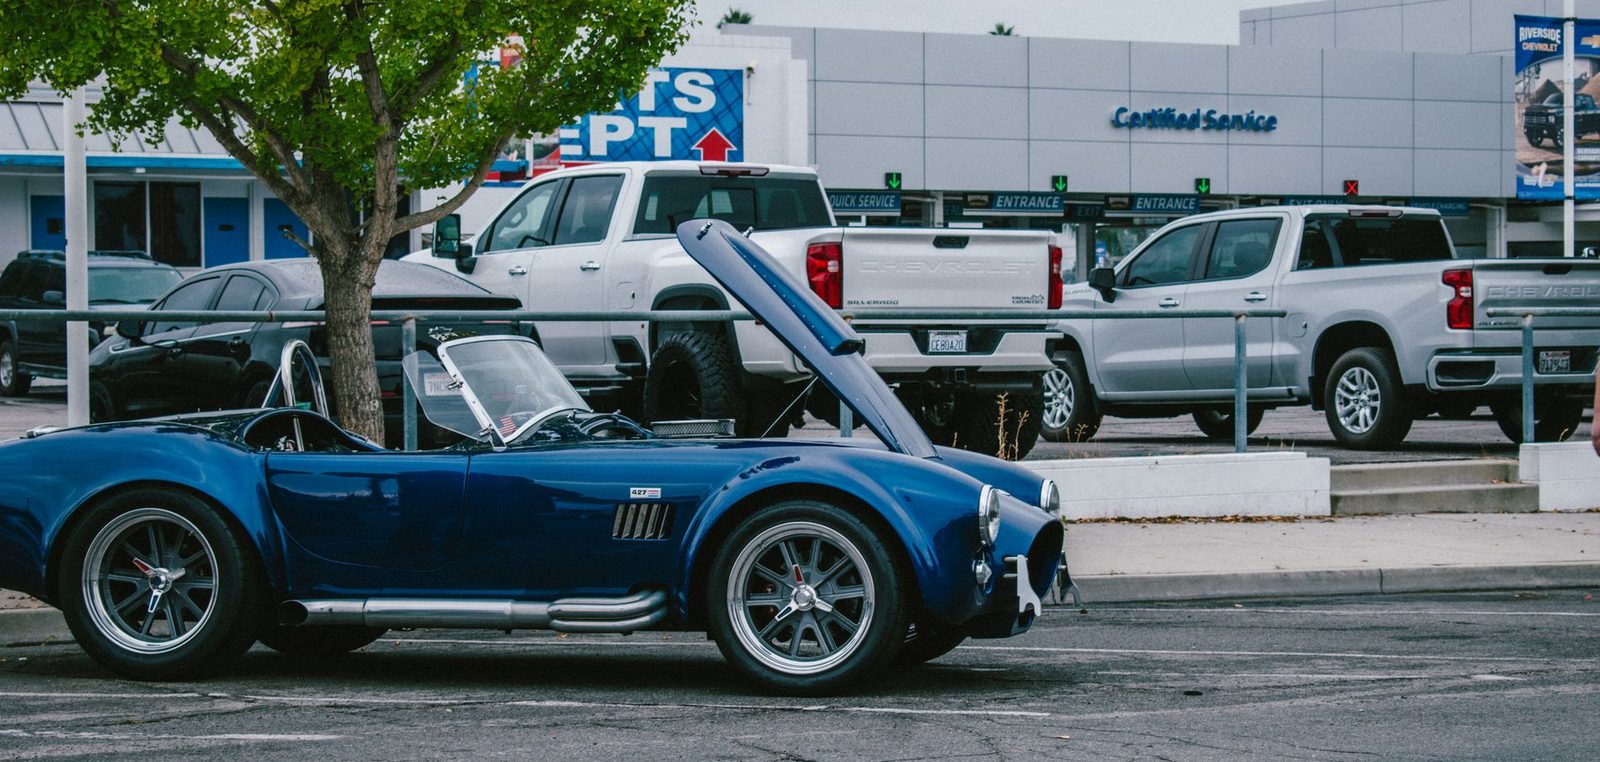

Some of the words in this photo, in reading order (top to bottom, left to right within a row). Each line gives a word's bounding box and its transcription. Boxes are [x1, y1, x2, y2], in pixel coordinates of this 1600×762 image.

[1519, 27, 1560, 44] RIVERSIDE
[1522, 42, 1558, 51] CHEVROLET
[1112, 107, 1200, 131] Certified
[1202, 110, 1278, 132] Service
[858, 195, 895, 207] SERVICE
[996, 195, 1060, 209] ENTRANCE
[1136, 197, 1196, 210] ENTRANCE
[859, 260, 1036, 275] CHEVROLET
